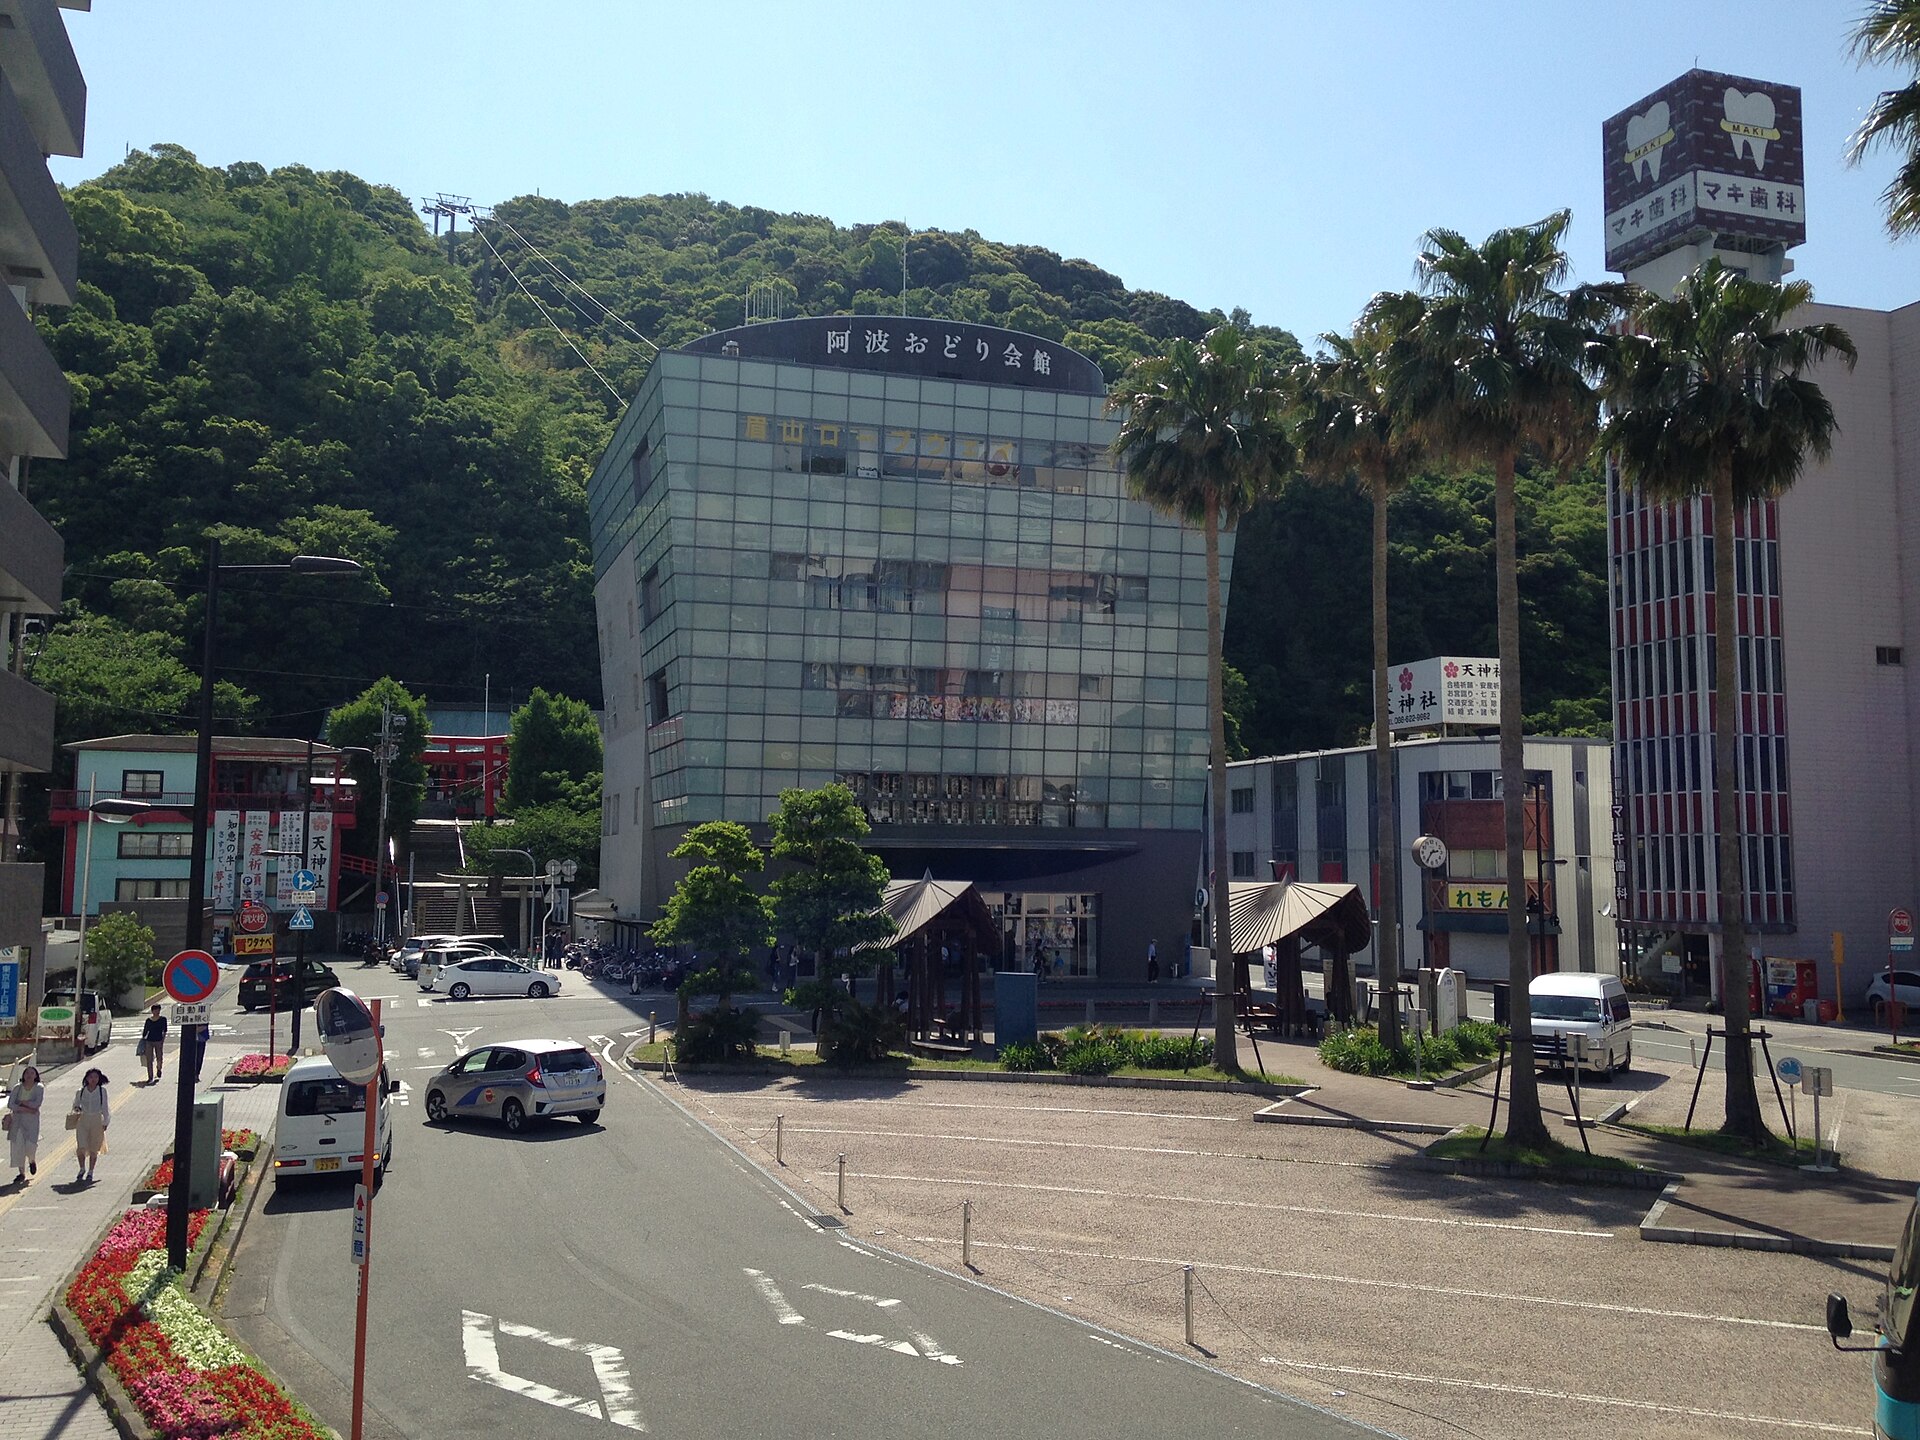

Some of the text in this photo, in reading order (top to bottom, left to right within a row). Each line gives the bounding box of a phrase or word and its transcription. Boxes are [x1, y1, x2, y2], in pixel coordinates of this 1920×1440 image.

[1732, 123, 1764, 136] MAKI
[1634, 138, 1662, 158] MAKI
[1611, 183, 1687, 236] マキ歯科
[1703, 181, 1797, 214] マキ歯科
[826, 329, 1051, 376] 阿波おどり会館
[1612, 805, 1628, 899] マキ歯科
[242, 913, 265, 924] 消火栓
[247, 938, 272, 947] ワタナベ
[176, 1005, 206, 1014] 自動車
[353, 1216, 364, 1258] 注意
